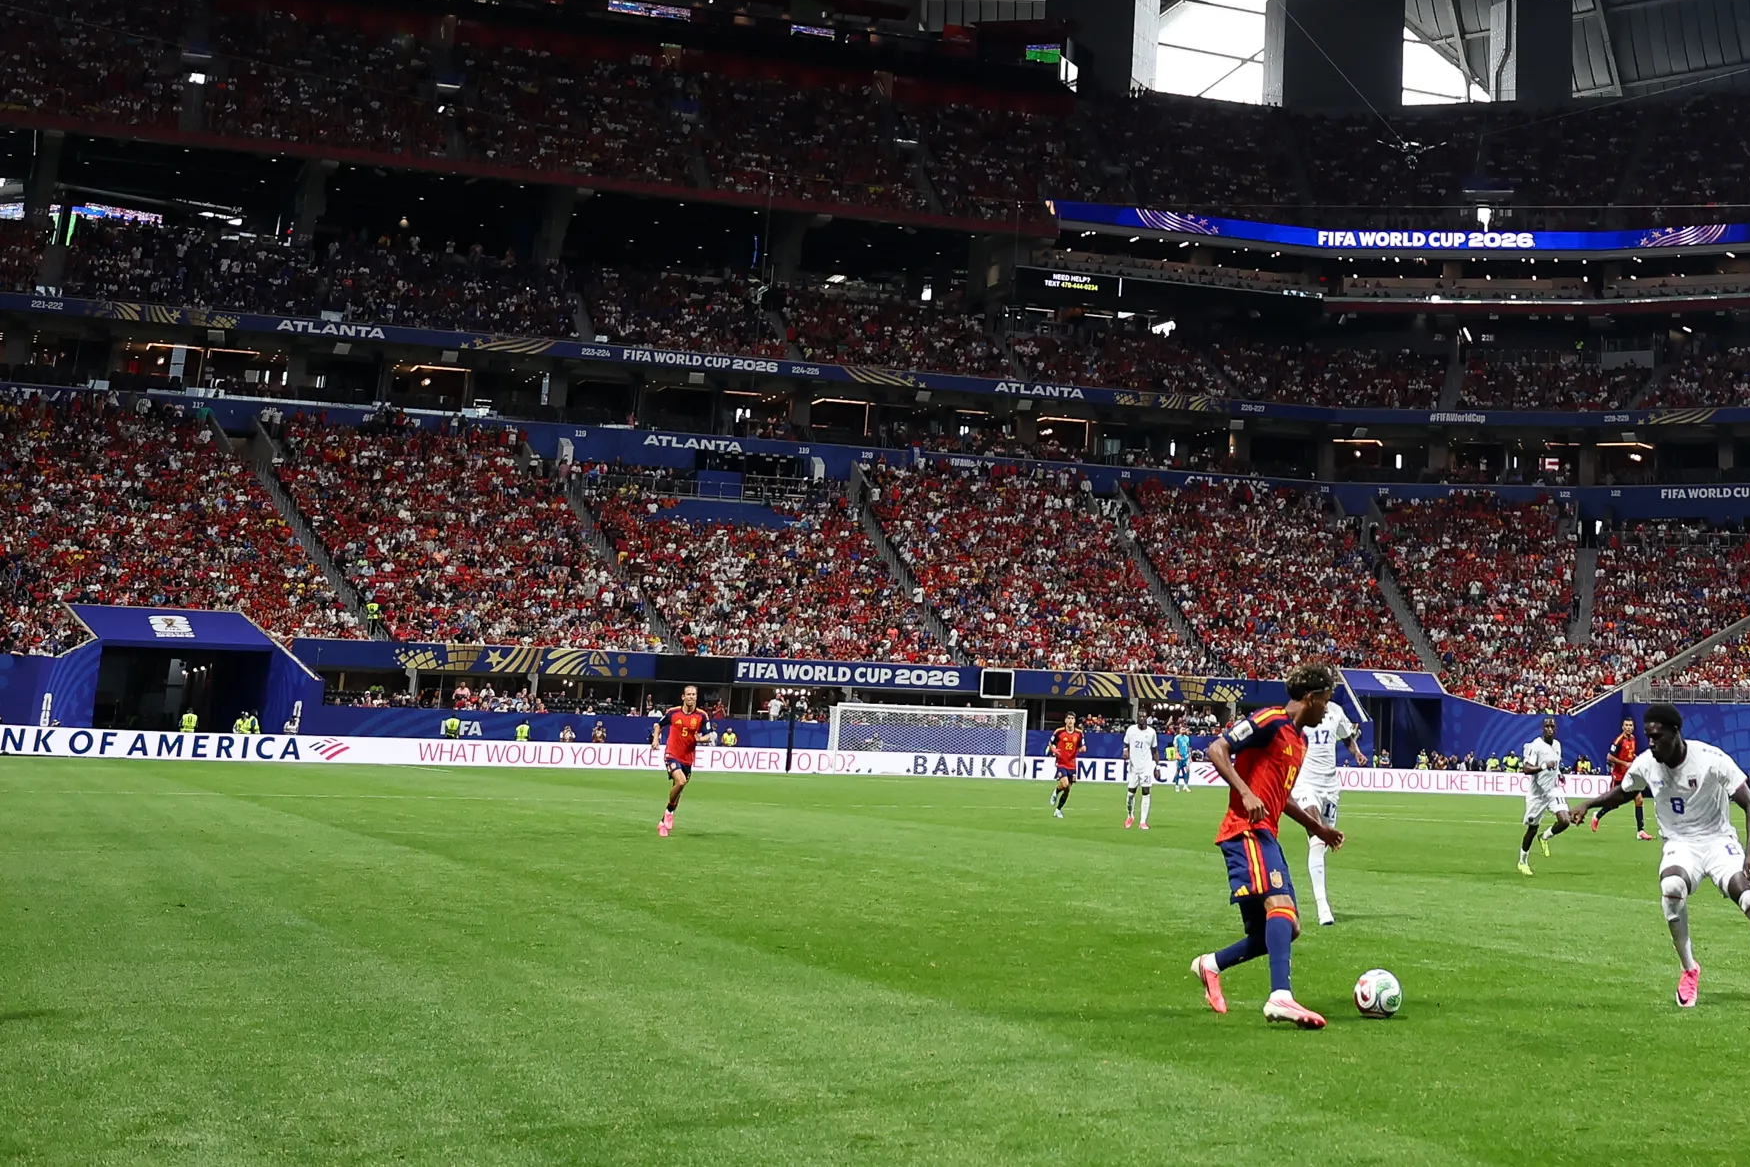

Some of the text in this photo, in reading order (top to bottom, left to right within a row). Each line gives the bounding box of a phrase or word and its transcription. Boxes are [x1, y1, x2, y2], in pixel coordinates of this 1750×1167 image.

[1318, 231, 1533, 247] FIFA WORLD CUP 2026
[1053, 273, 1091, 283] NEED HELP?
[31, 300, 64, 310] 221-222
[276, 319, 386, 339] ATLANTA
[581, 347, 820, 376] 223-224 FIFA WORLD CUP 2026 224-225
[995, 382, 1085, 399] ATLANTA
[1430, 413, 1485, 424] #FIFAWorldCup
[643, 435, 742, 453] ATLANTA
[1661, 488, 1686, 499] FIFA
[1688, 488, 1733, 499] WORLD
[737, 661, 960, 686] FIFA WORLD CUP 2026
[440, 720, 483, 736] FFA
[681, 727, 688, 737] 5
[1135, 741, 1144, 749] 21
[1315, 730, 1330, 744] 17
[69, 731, 118, 755] OF
[127, 734, 301, 760] AMERICA
[1064, 742, 1073, 751] 22
[419, 743, 660, 767] WHAT WOULD YOU LIKE
[711, 749, 780, 770] POWER
[791, 752, 811, 770] TO
[817, 753, 856, 773] DO?
[914, 755, 996, 777] BANK
[1008, 757, 1045, 779] OF
[1284, 765, 1297, 789] 19
[1336, 770, 1393, 789] WOULD
[1399, 771, 1435, 789] YOU
[1437, 774, 1469, 790] LIKE
[1473, 775, 1505, 792] THE
[1570, 778, 1593, 795] TO
[1325, 802, 1336, 818] 17
[1670, 797, 1684, 814] 8
[1725, 843, 1740, 855] 8
